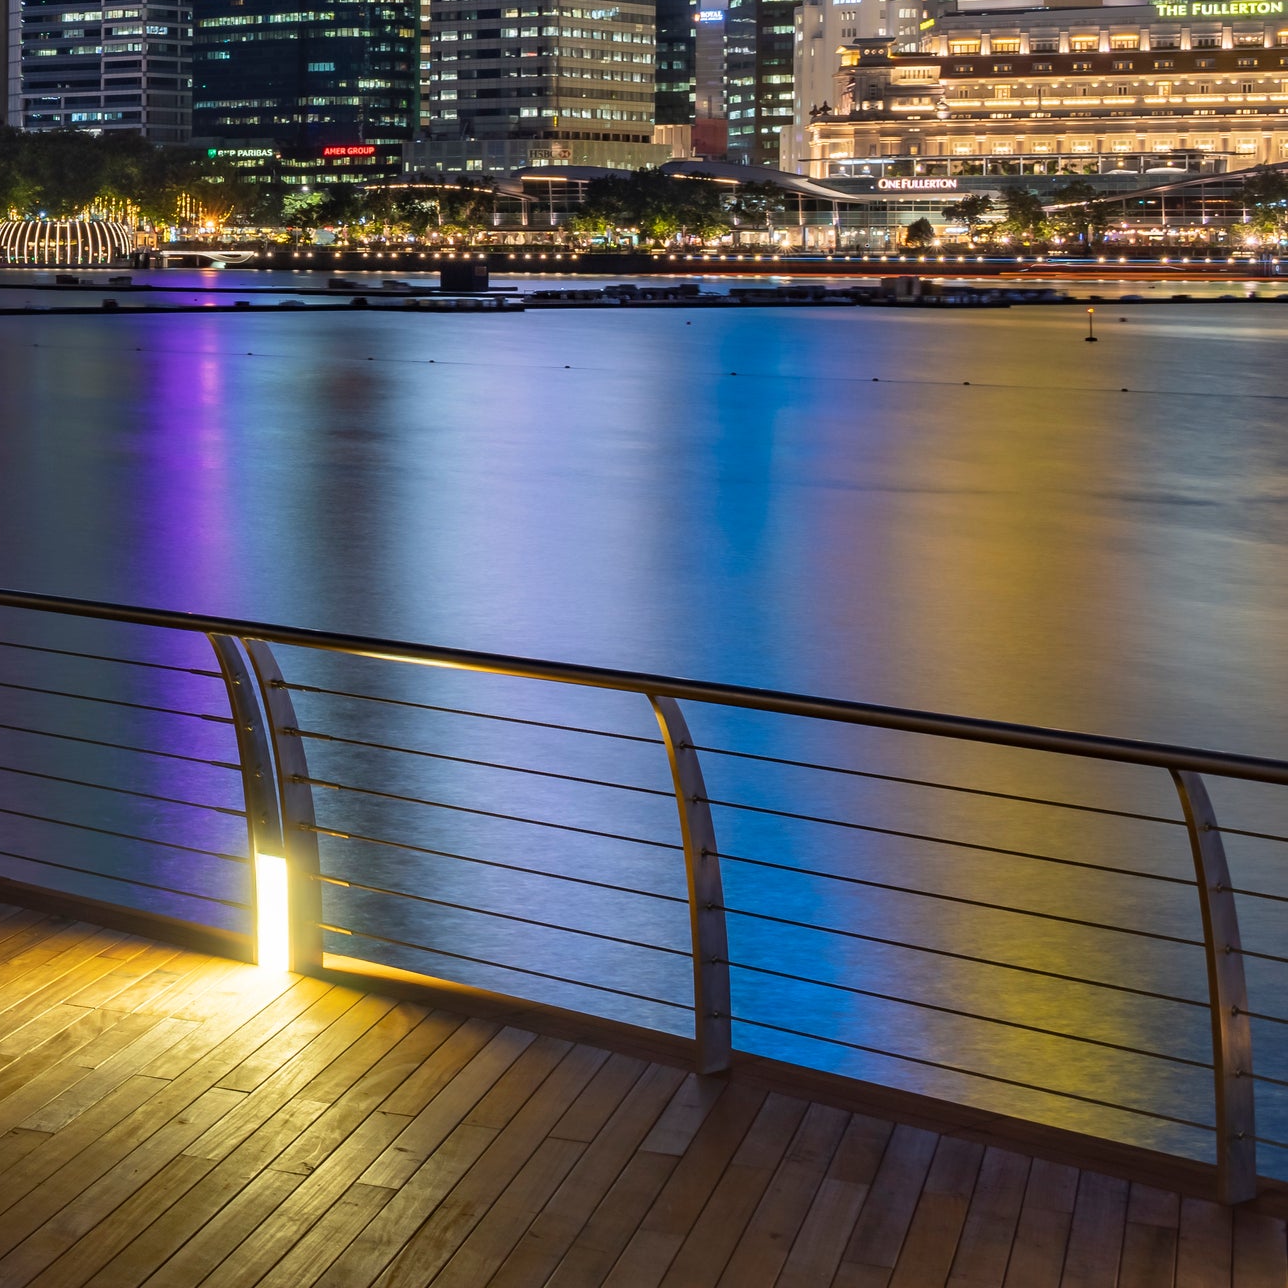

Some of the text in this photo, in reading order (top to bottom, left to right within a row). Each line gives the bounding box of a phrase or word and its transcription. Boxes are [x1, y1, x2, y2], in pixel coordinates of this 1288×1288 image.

[1156, 1, 1283, 16] THE FULLERTON
[237, 148, 273, 157] PARIBAS
[347, 146, 375, 155] GROUP
[529, 149, 556, 158] HSBC
[878, 178, 957, 189] ONE FULLERTON
